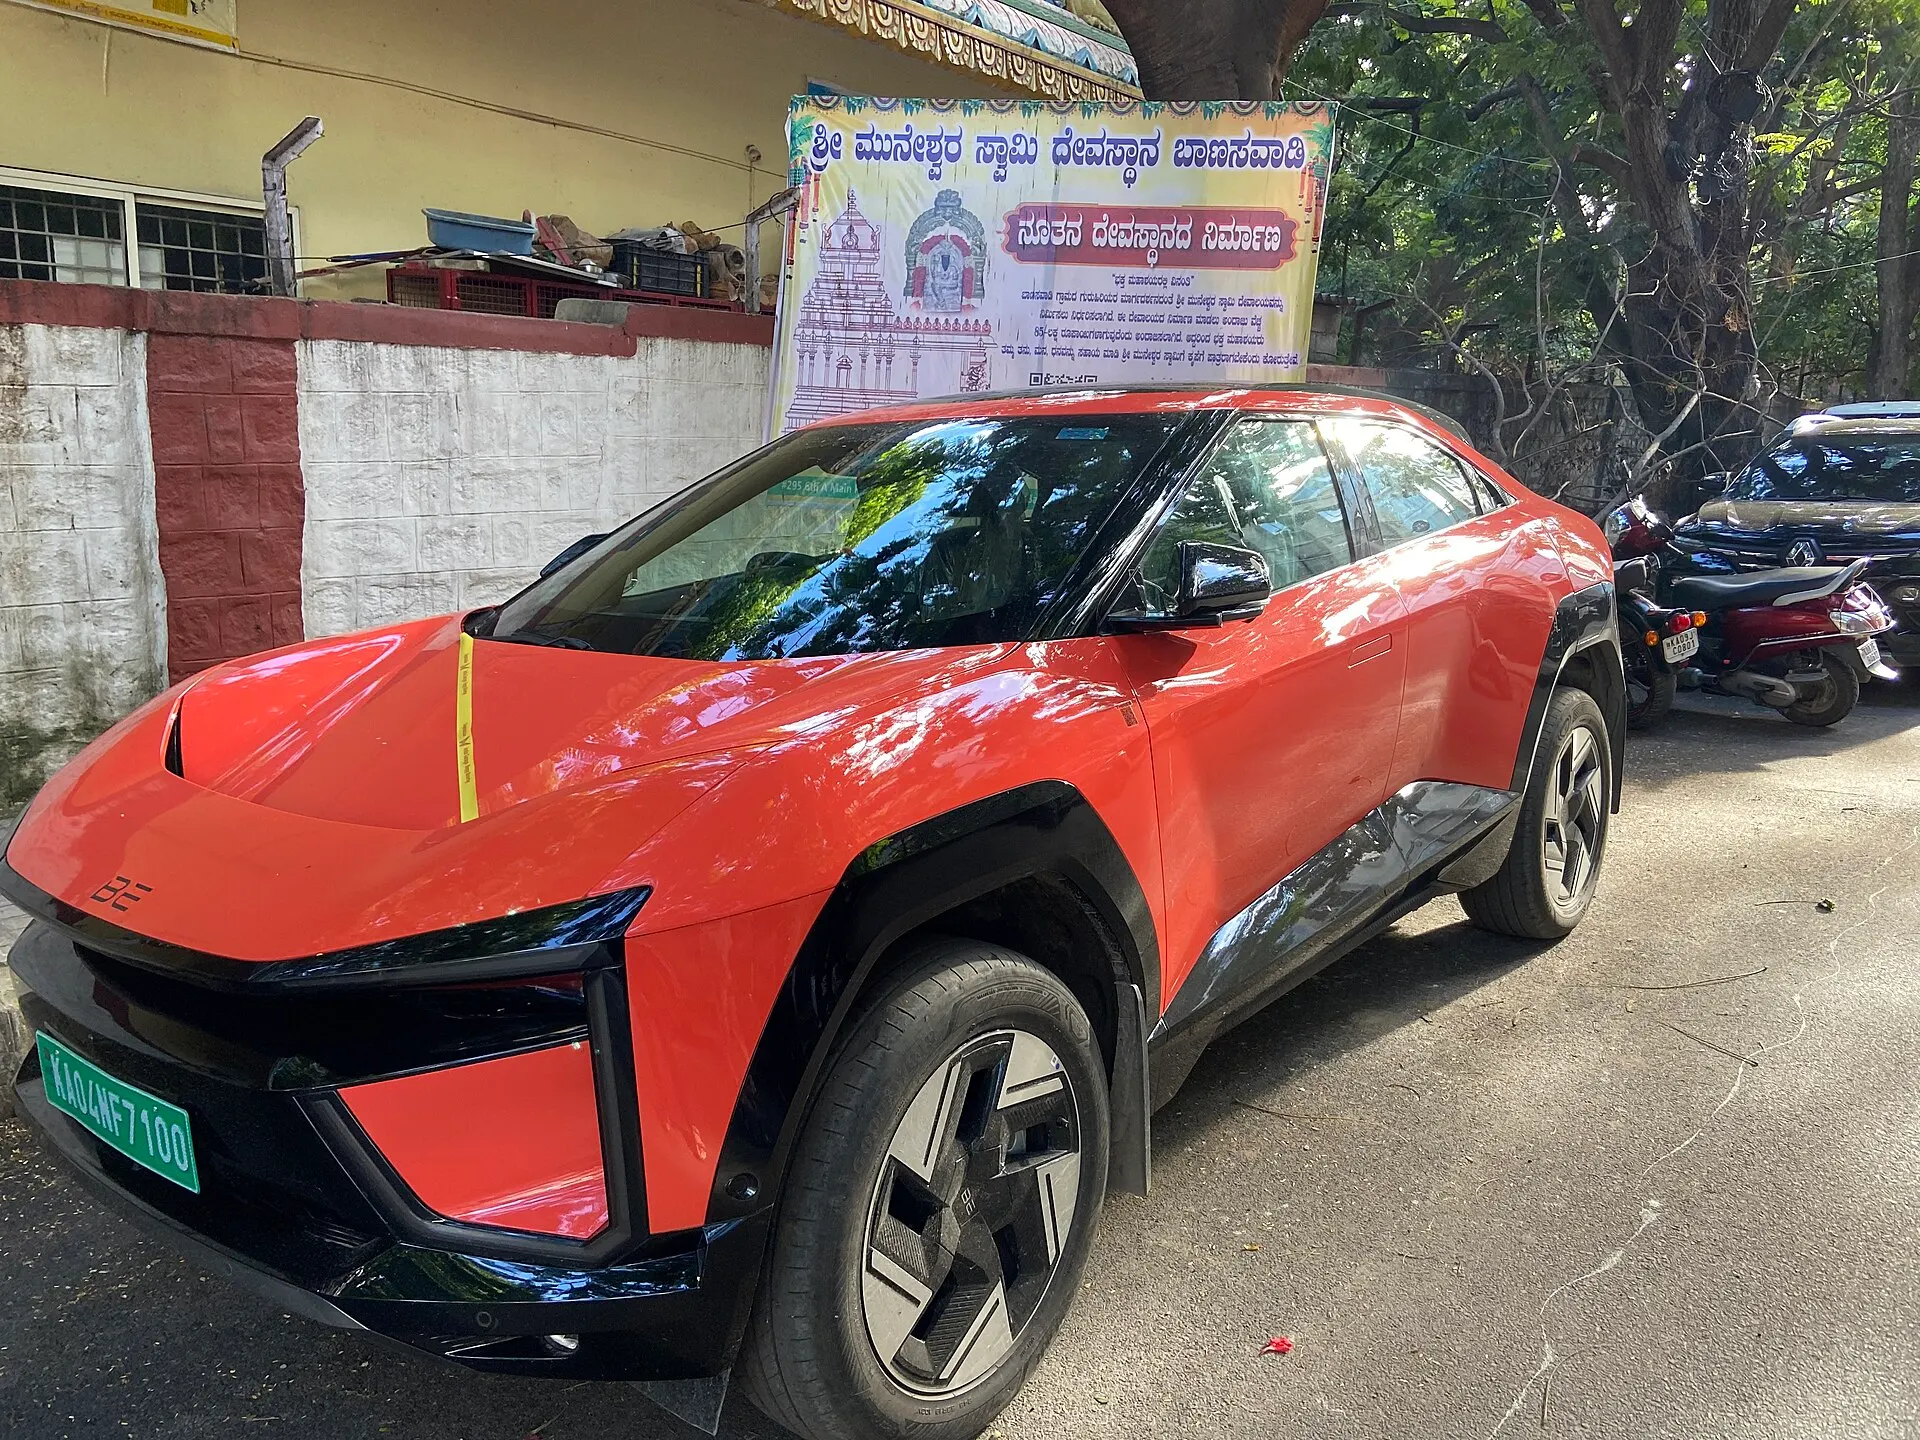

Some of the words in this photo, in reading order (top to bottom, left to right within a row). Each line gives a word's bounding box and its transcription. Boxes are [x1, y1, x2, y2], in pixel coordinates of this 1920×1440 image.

[810, 123, 842, 171] ಶ್ರೀ
[855, 123, 963, 181] ಮುನೇಶ್ವರ
[975, 132, 1038, 182] ಸ್ವಾಮಿ
[1052, 127, 1161, 188] ದೇವಸ್ಥಾನ
[1173, 129, 1306, 169] ಬಾಣಸವಾಡಿ
[1017, 211, 1083, 246] ನೂತನ
[1092, 213, 1193, 268] ದೇವಸ್ಥಾನದ
[1202, 215, 1281, 251] ನಿರ್ಮಾಣ
[1175, 294, 1185, 309] ಶ್ರೀ
[1187, 294, 1216, 311] ಮುನೇಶ್ವರ
[1121, 347, 1131, 363] ಶ್ರೀ
[820, 482, 828, 492] A
[830, 482, 852, 494] Main
